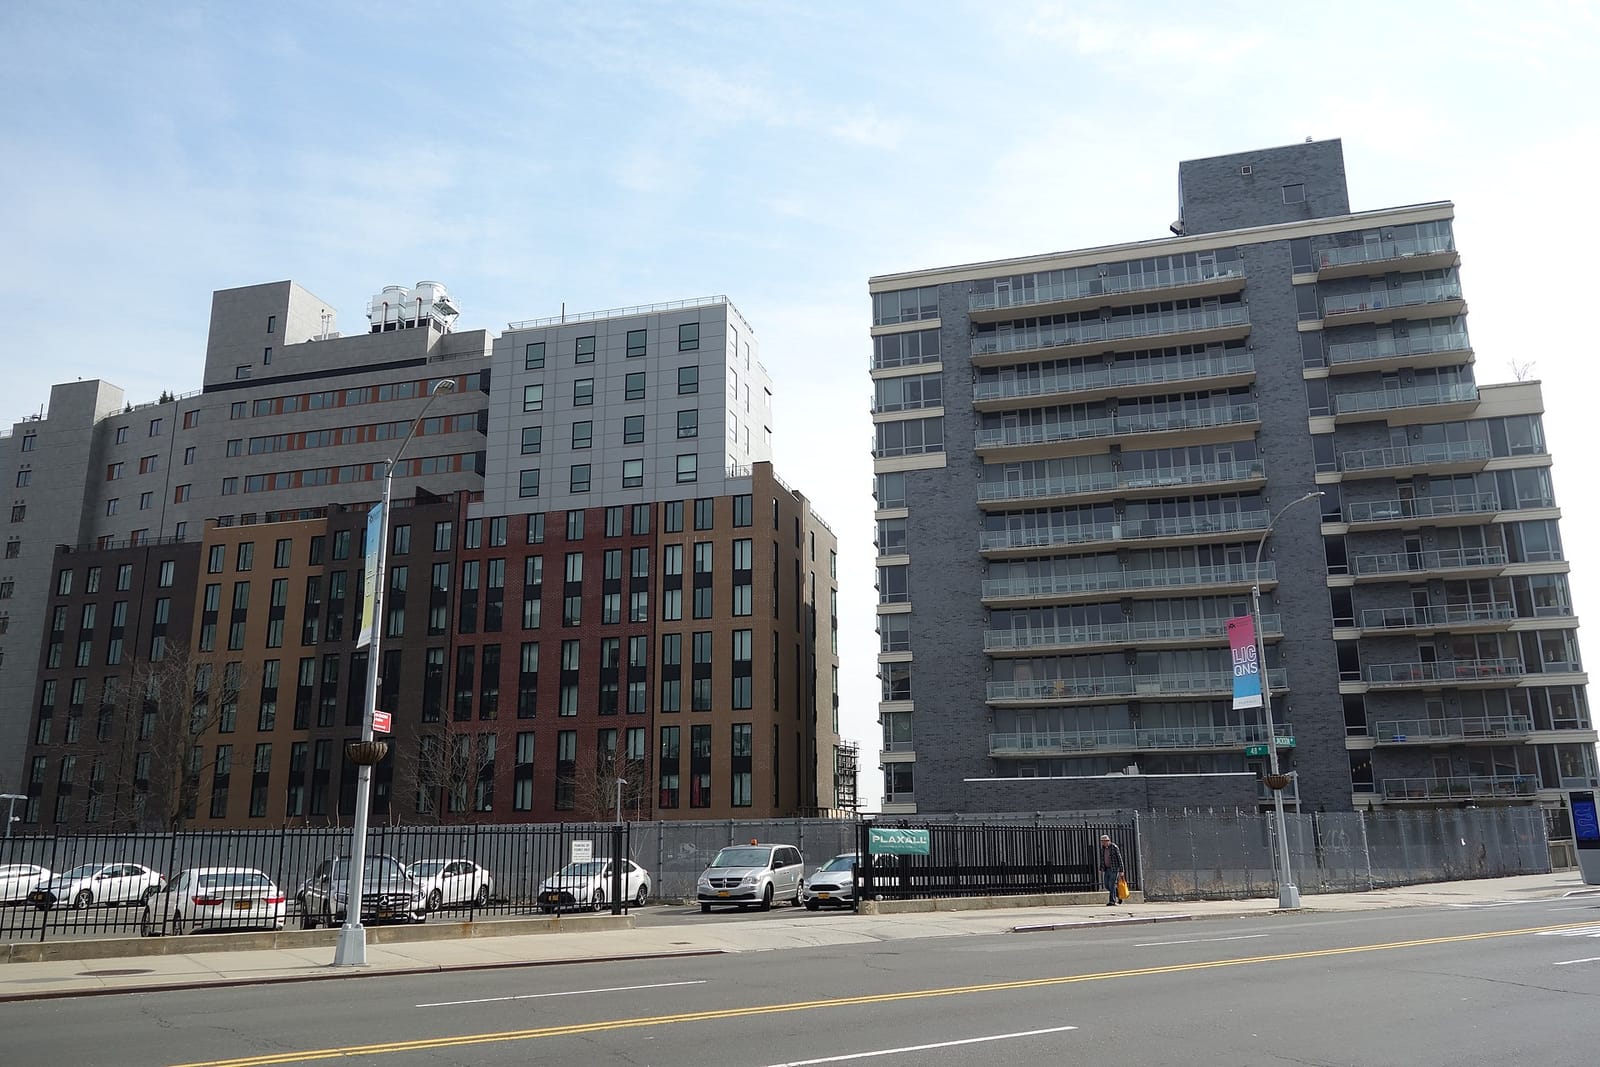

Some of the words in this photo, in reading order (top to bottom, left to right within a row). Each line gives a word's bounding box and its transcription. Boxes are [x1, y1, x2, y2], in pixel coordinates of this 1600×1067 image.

[1232, 645, 1257, 664] LIC
[1234, 662, 1258, 677] QNS
[872, 835, 927, 844] PLAXALL
